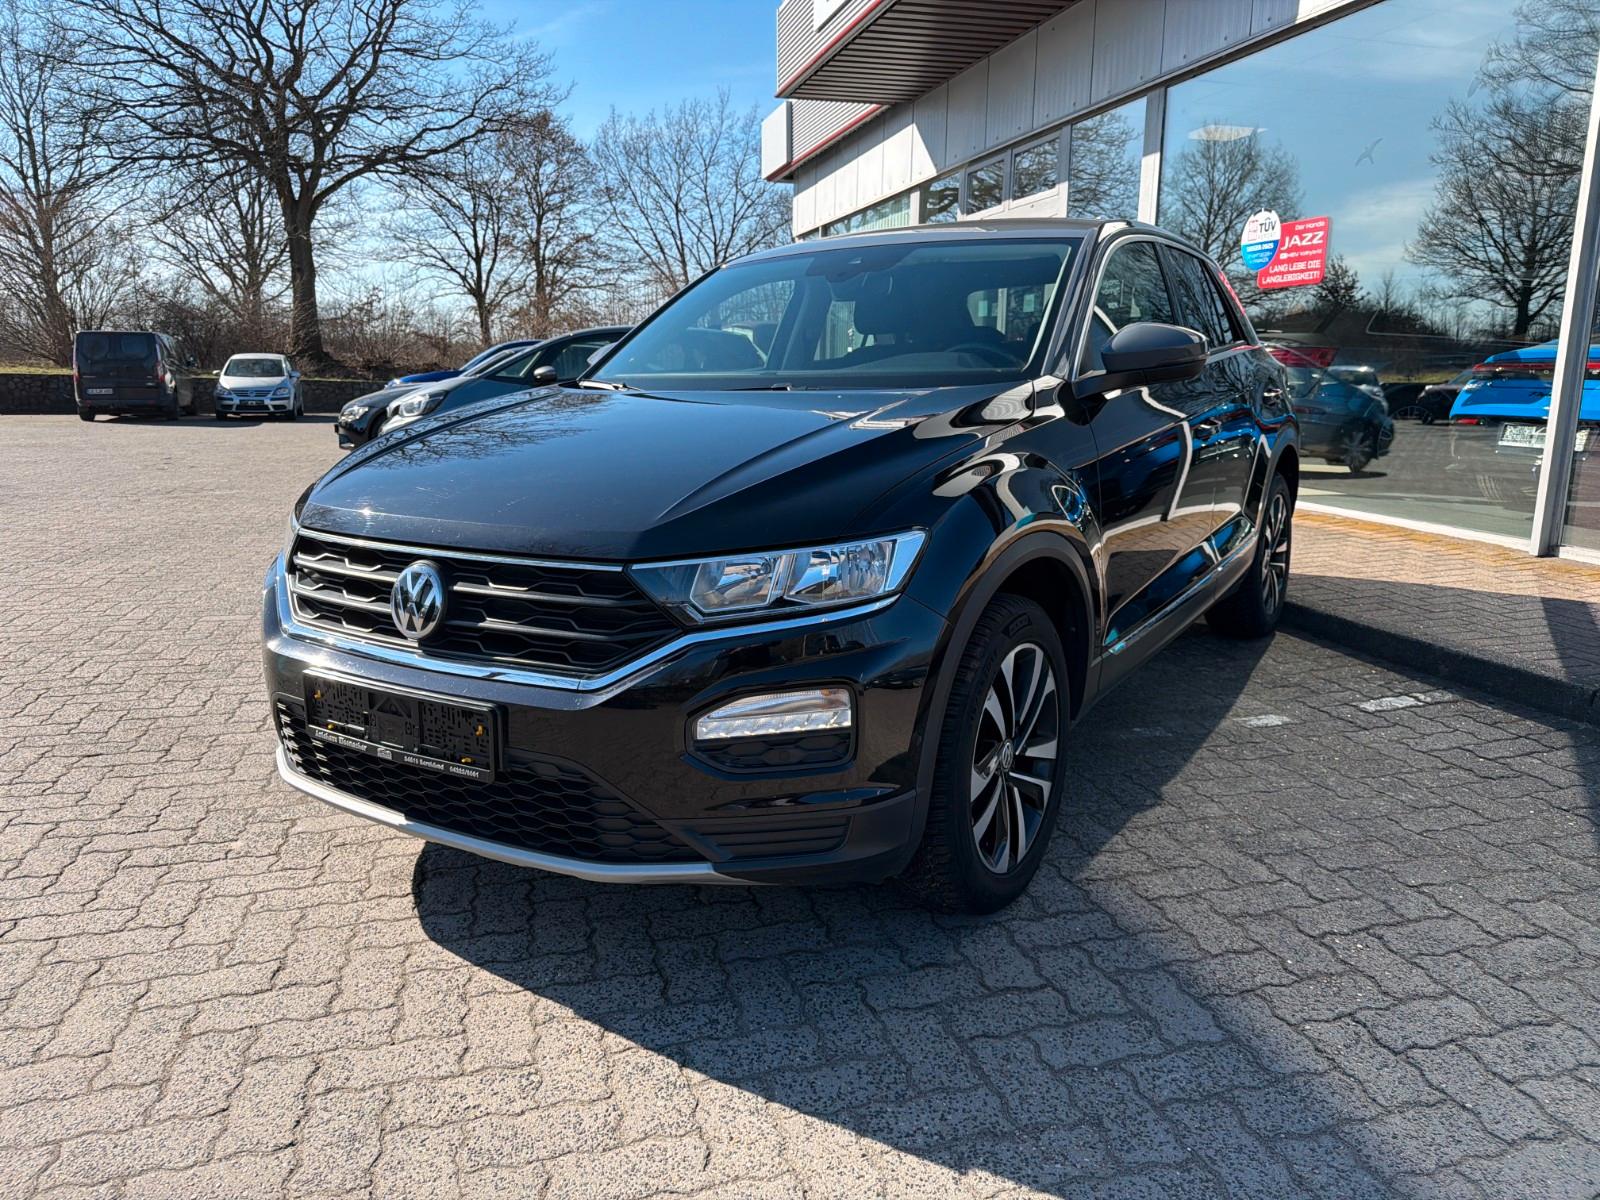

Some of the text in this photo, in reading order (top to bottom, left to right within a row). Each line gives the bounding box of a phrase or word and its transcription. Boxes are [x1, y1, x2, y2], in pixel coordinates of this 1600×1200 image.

[1259, 217, 1277, 233] TÜV
[1280, 231, 1324, 250] JAZZ
[1269, 259, 1321, 274] LANG LEBE DIE
